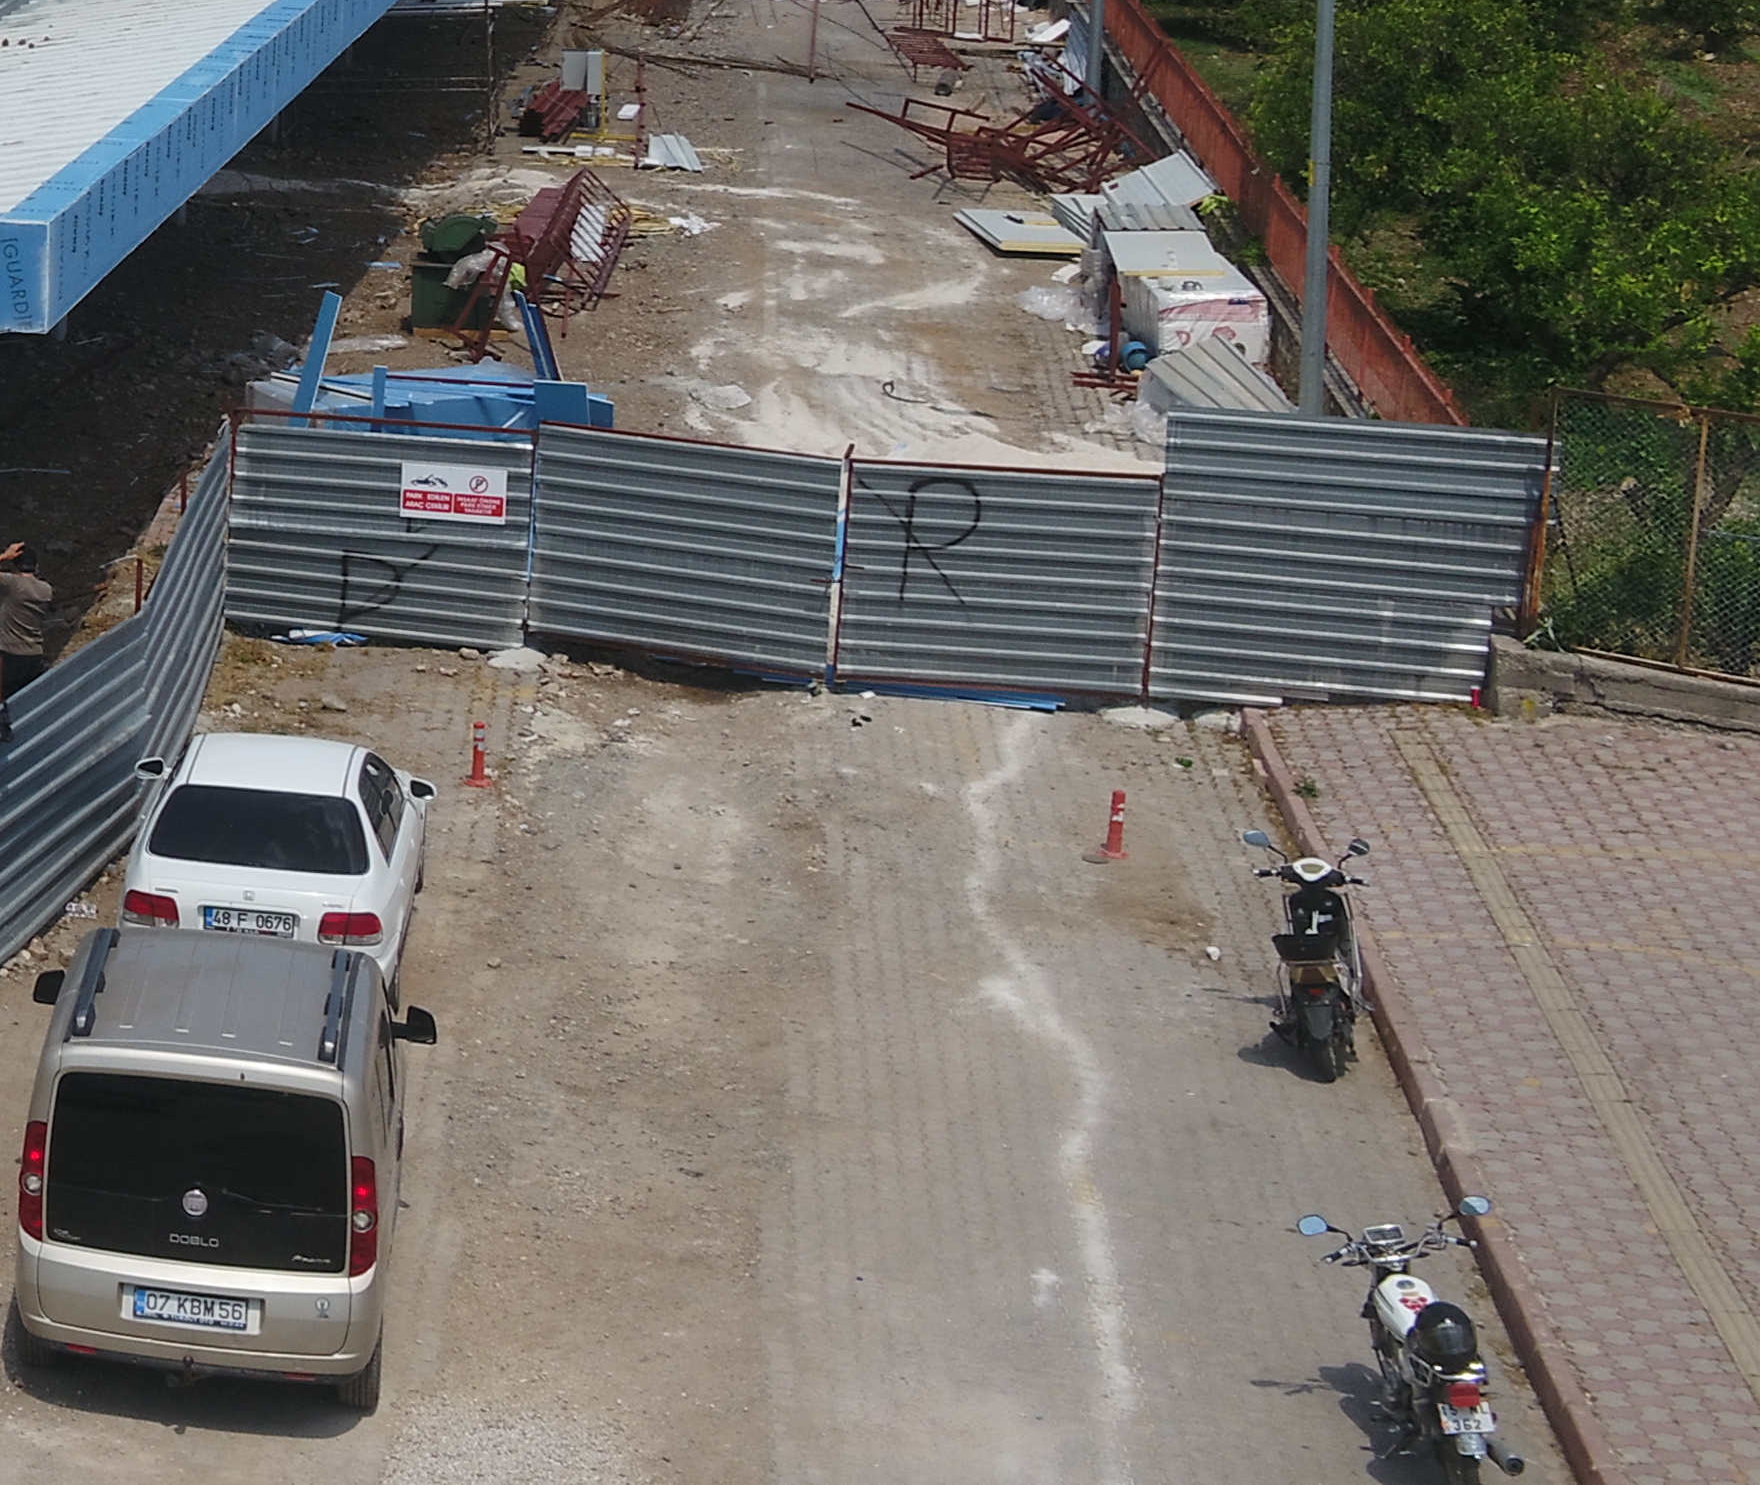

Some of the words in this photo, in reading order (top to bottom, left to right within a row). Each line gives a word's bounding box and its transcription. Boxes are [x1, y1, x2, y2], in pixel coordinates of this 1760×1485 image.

[213, 910, 231, 926] 48
[237, 912, 248, 927] F
[255, 914, 292, 931] 0676
[169, 1233, 219, 1247] DOBLO
[146, 1292, 171, 1312] 07
[177, 1296, 215, 1318] KBM
[218, 1302, 244, 1321] 56
